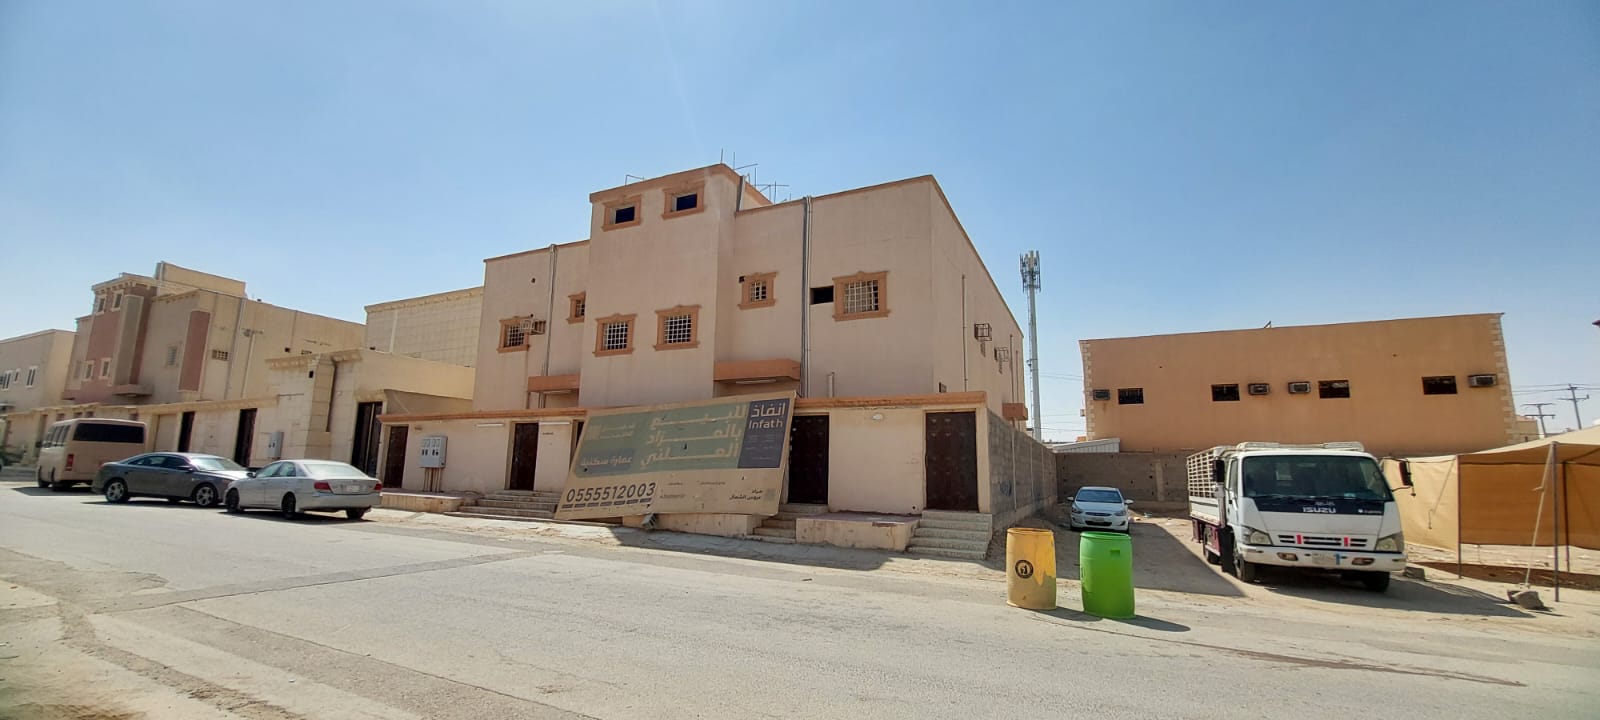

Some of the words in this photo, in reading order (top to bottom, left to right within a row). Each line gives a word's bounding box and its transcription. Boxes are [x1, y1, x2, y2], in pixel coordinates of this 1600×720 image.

[748, 418, 783, 429] Infath
[566, 482, 656, 502] 0555512003
[1302, 506, 1337, 514] ISUZU
